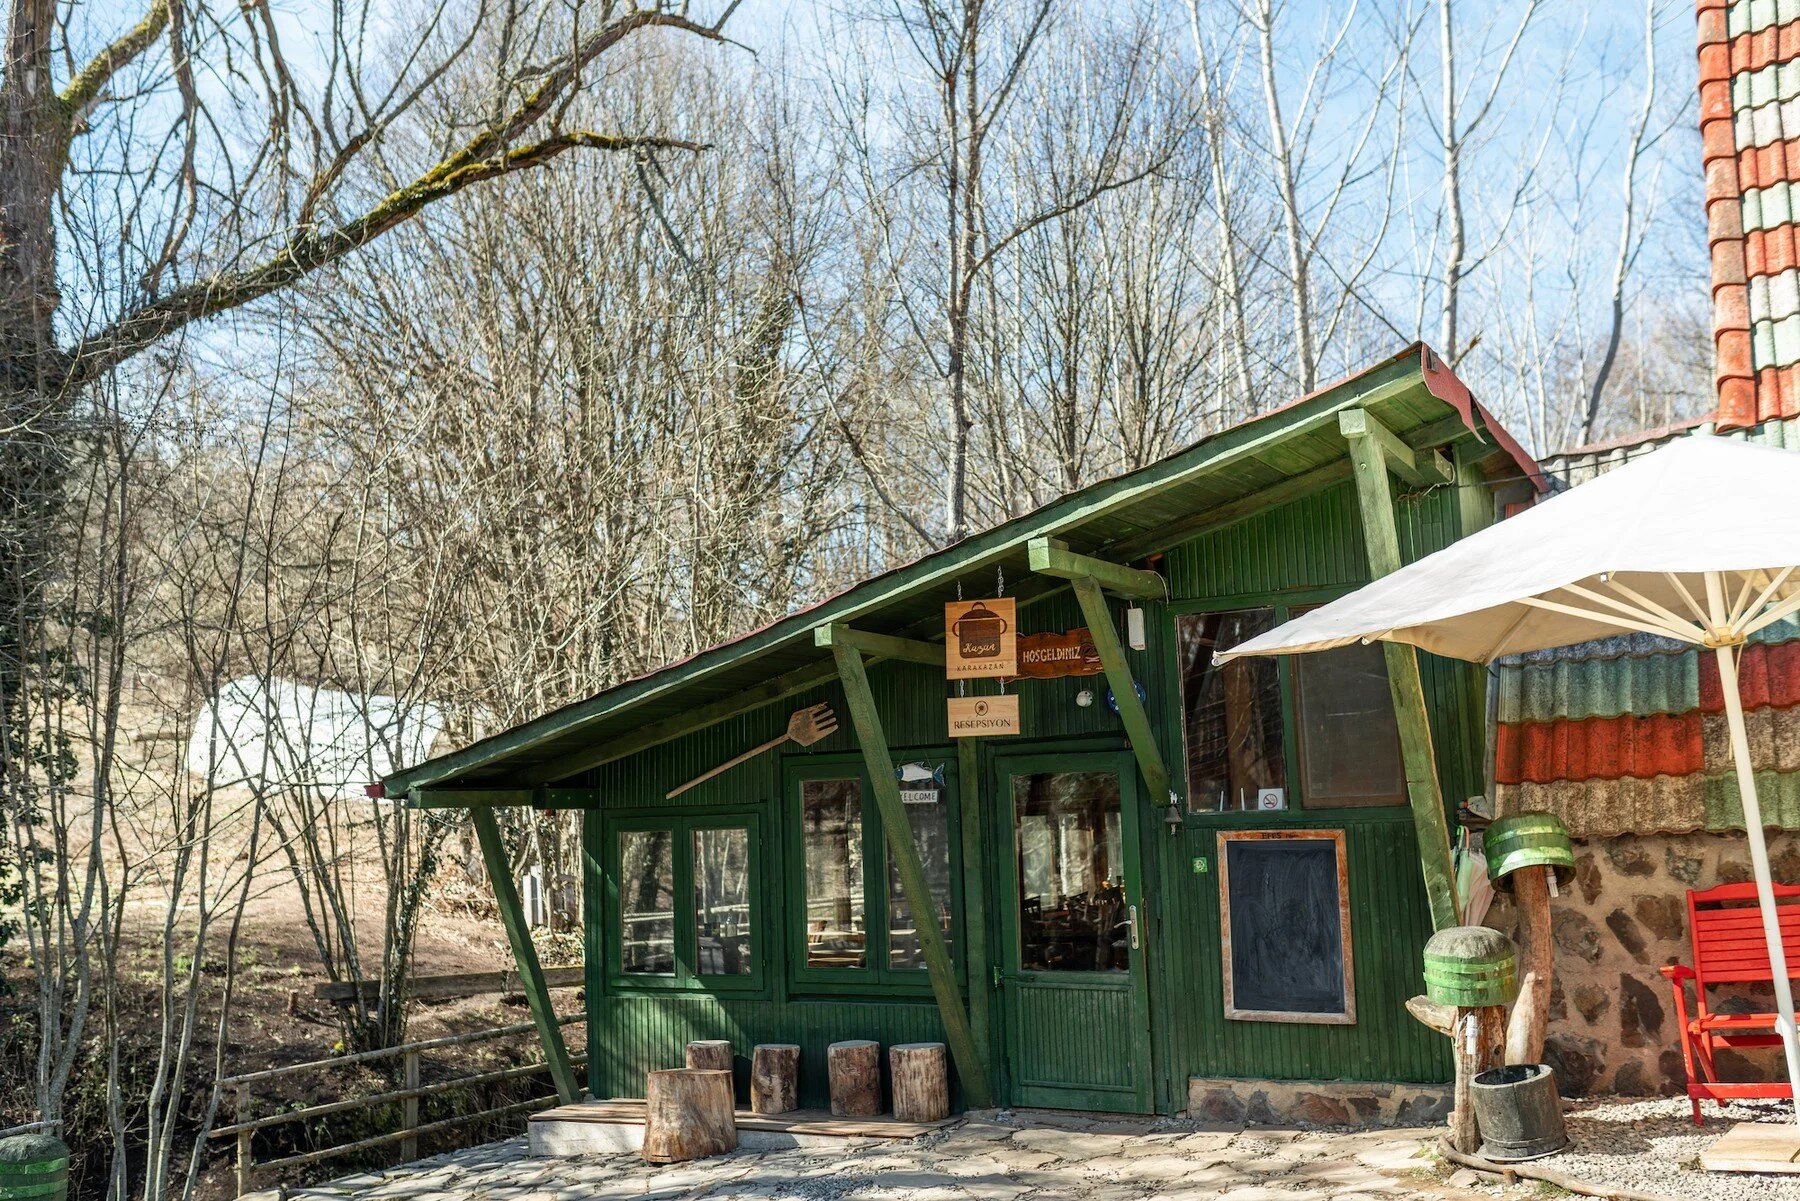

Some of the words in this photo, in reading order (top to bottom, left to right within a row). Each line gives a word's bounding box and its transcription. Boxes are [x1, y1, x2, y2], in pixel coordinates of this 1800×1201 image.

[962, 642, 997, 655] Kazan
[956, 662, 1005, 672] KARAKAZAN
[900, 792, 937, 802] ELCOME
